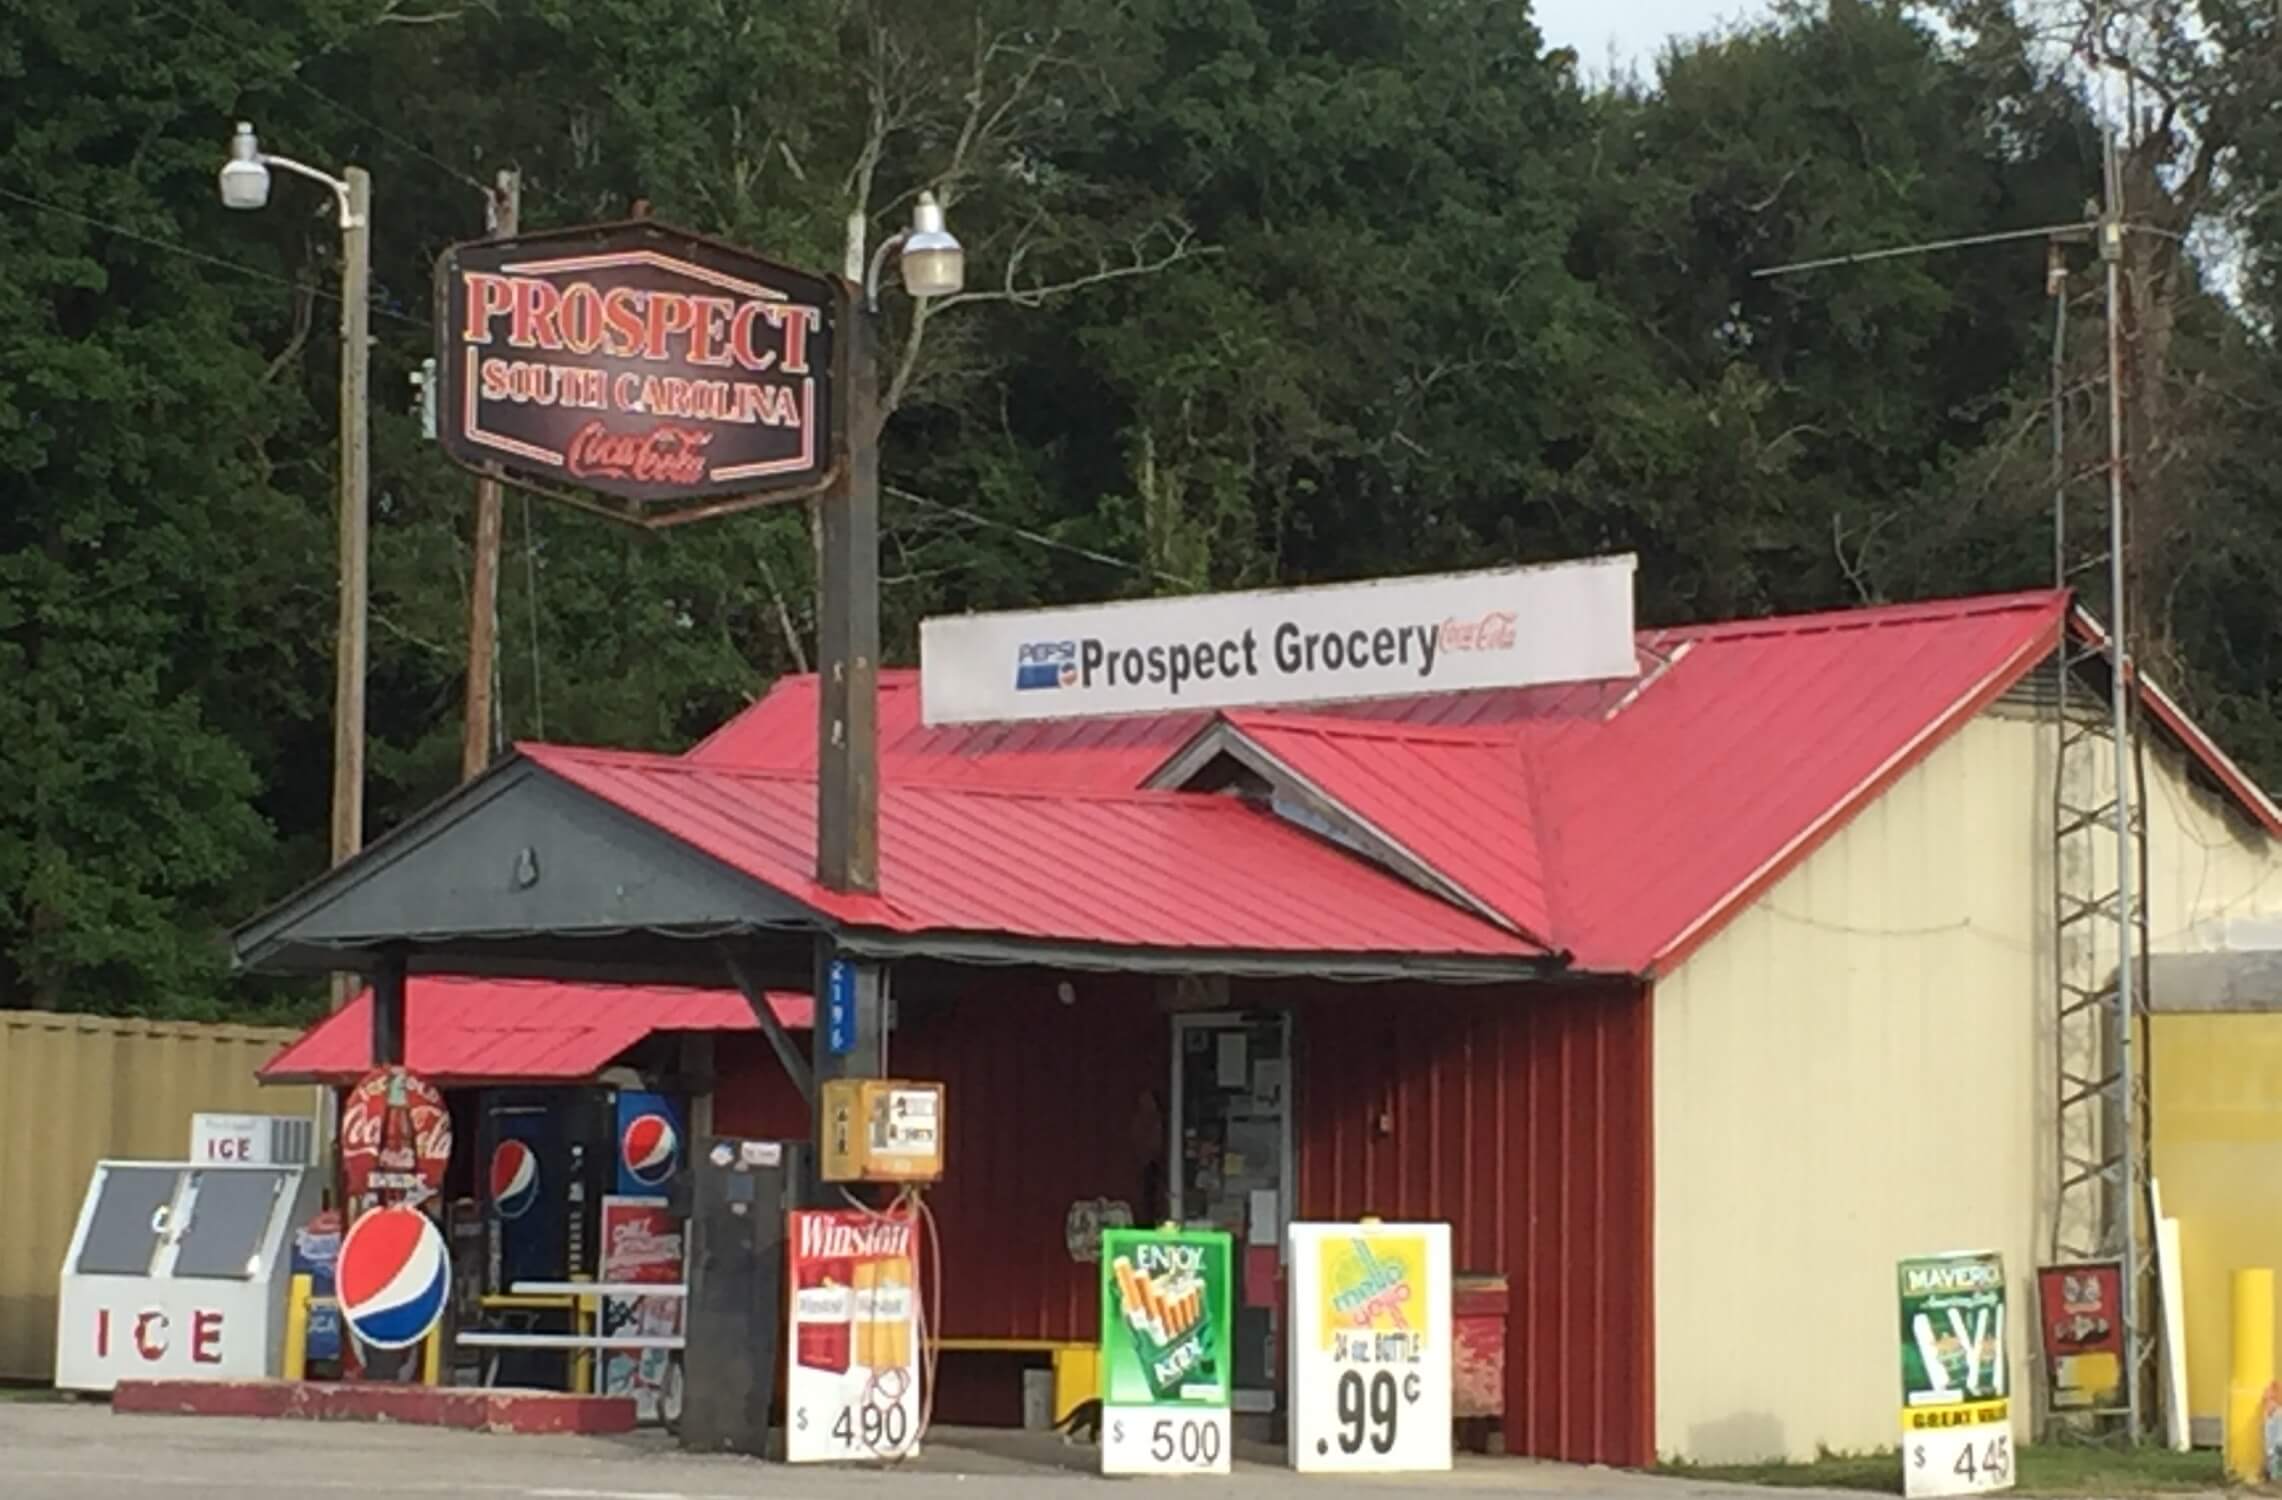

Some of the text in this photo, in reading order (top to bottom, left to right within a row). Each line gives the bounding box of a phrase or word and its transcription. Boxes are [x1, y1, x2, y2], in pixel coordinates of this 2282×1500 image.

[463, 272, 821, 373] PROSPECT
[481, 358, 801, 427] SOUTH CAROLINA
[1018, 640, 1076, 662] PEPSI
[1080, 621, 1440, 694] Prospect Grocery
[208, 1138, 251, 1160] ICE
[800, 1214, 910, 1259] Winston
[1137, 1244, 1207, 1274] ENJOY
[96, 1308, 224, 1364] ICE
[1913, 1410, 1972, 1429] GREAT
